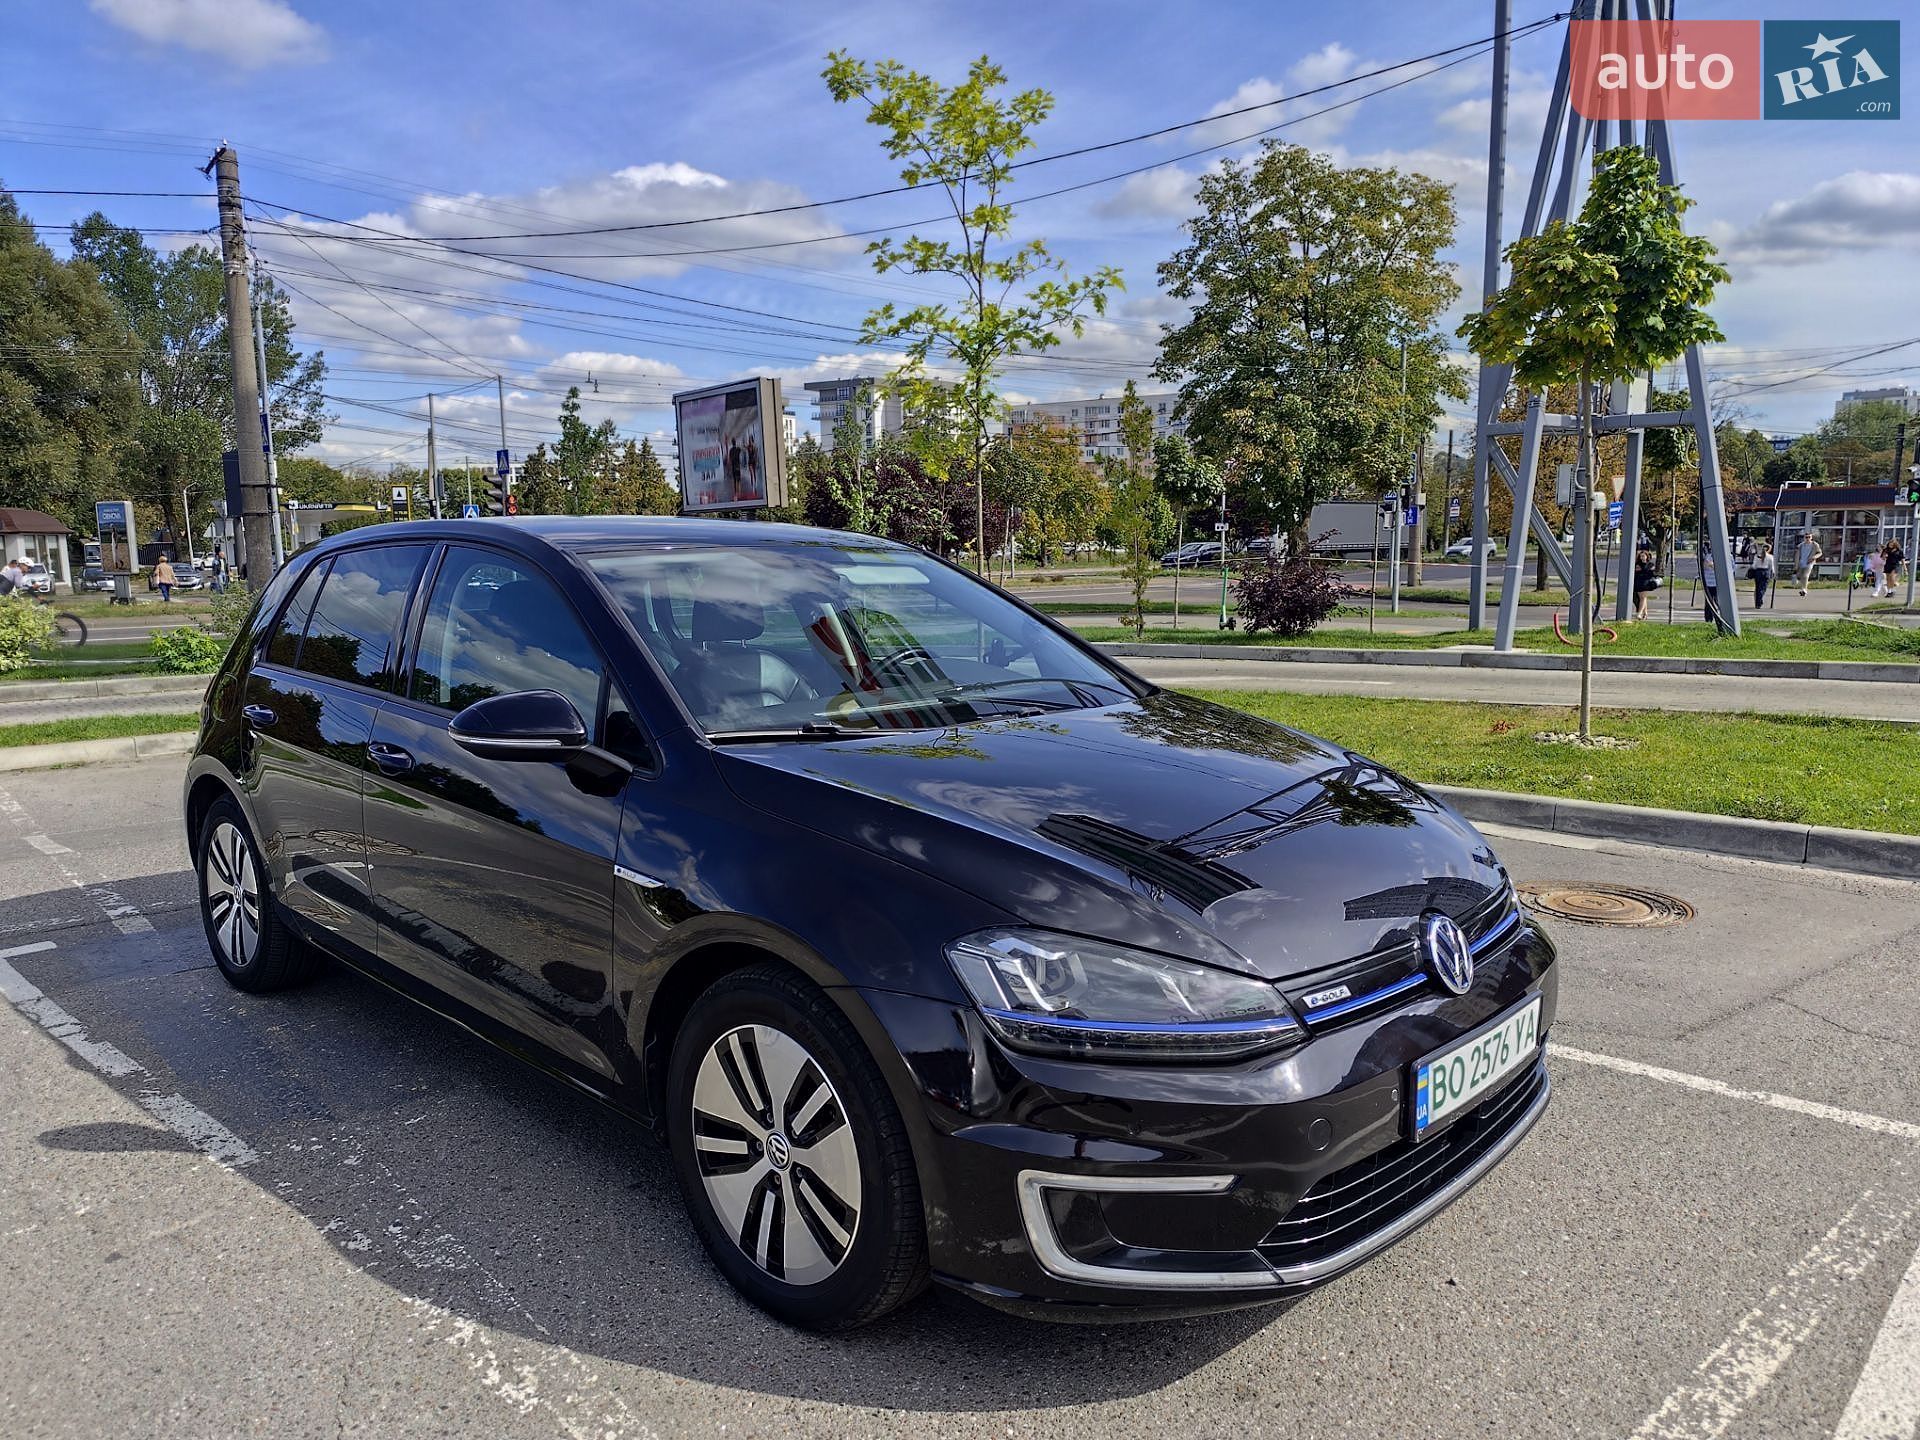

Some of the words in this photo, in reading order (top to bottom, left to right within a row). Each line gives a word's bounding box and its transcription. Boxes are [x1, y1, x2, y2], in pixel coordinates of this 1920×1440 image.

[1432, 1056, 1465, 1111] BO
[1470, 1025, 1510, 1089] 2576
[1516, 1009, 1535, 1055] YA
[1417, 1103, 1427, 1120] UA
